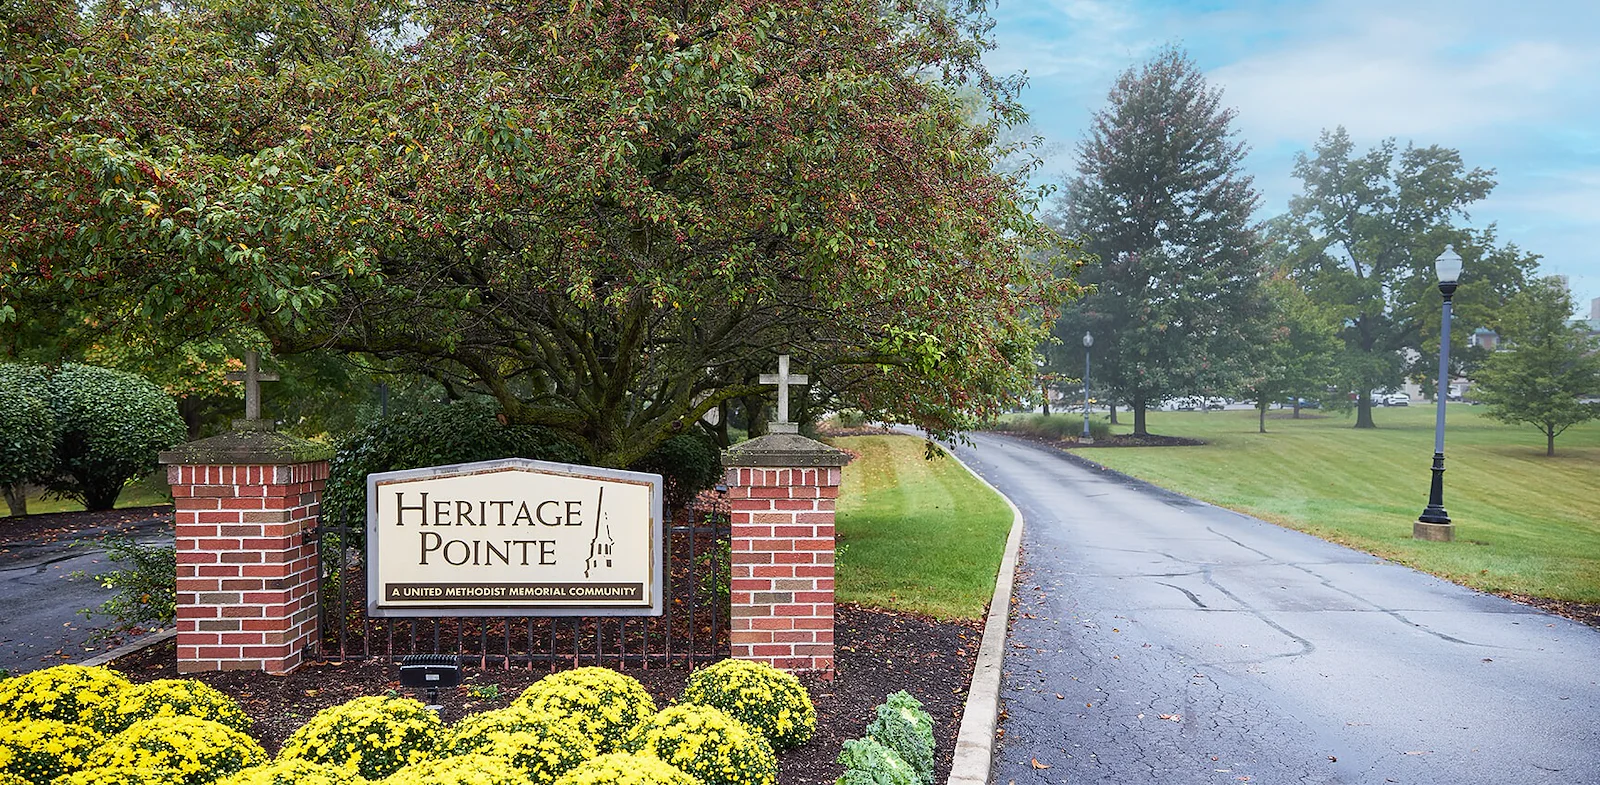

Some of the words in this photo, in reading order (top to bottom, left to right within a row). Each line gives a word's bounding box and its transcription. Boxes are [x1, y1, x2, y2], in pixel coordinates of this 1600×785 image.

[395, 492, 582, 526] HERITAGE
[418, 531, 556, 566] POINTE
[391, 588, 401, 597] A
[403, 588, 442, 597] UNITED
[445, 588, 506, 597] METHODIST
[509, 587, 567, 596] MEMORIAL
[569, 587, 637, 596] COMMUNITY
